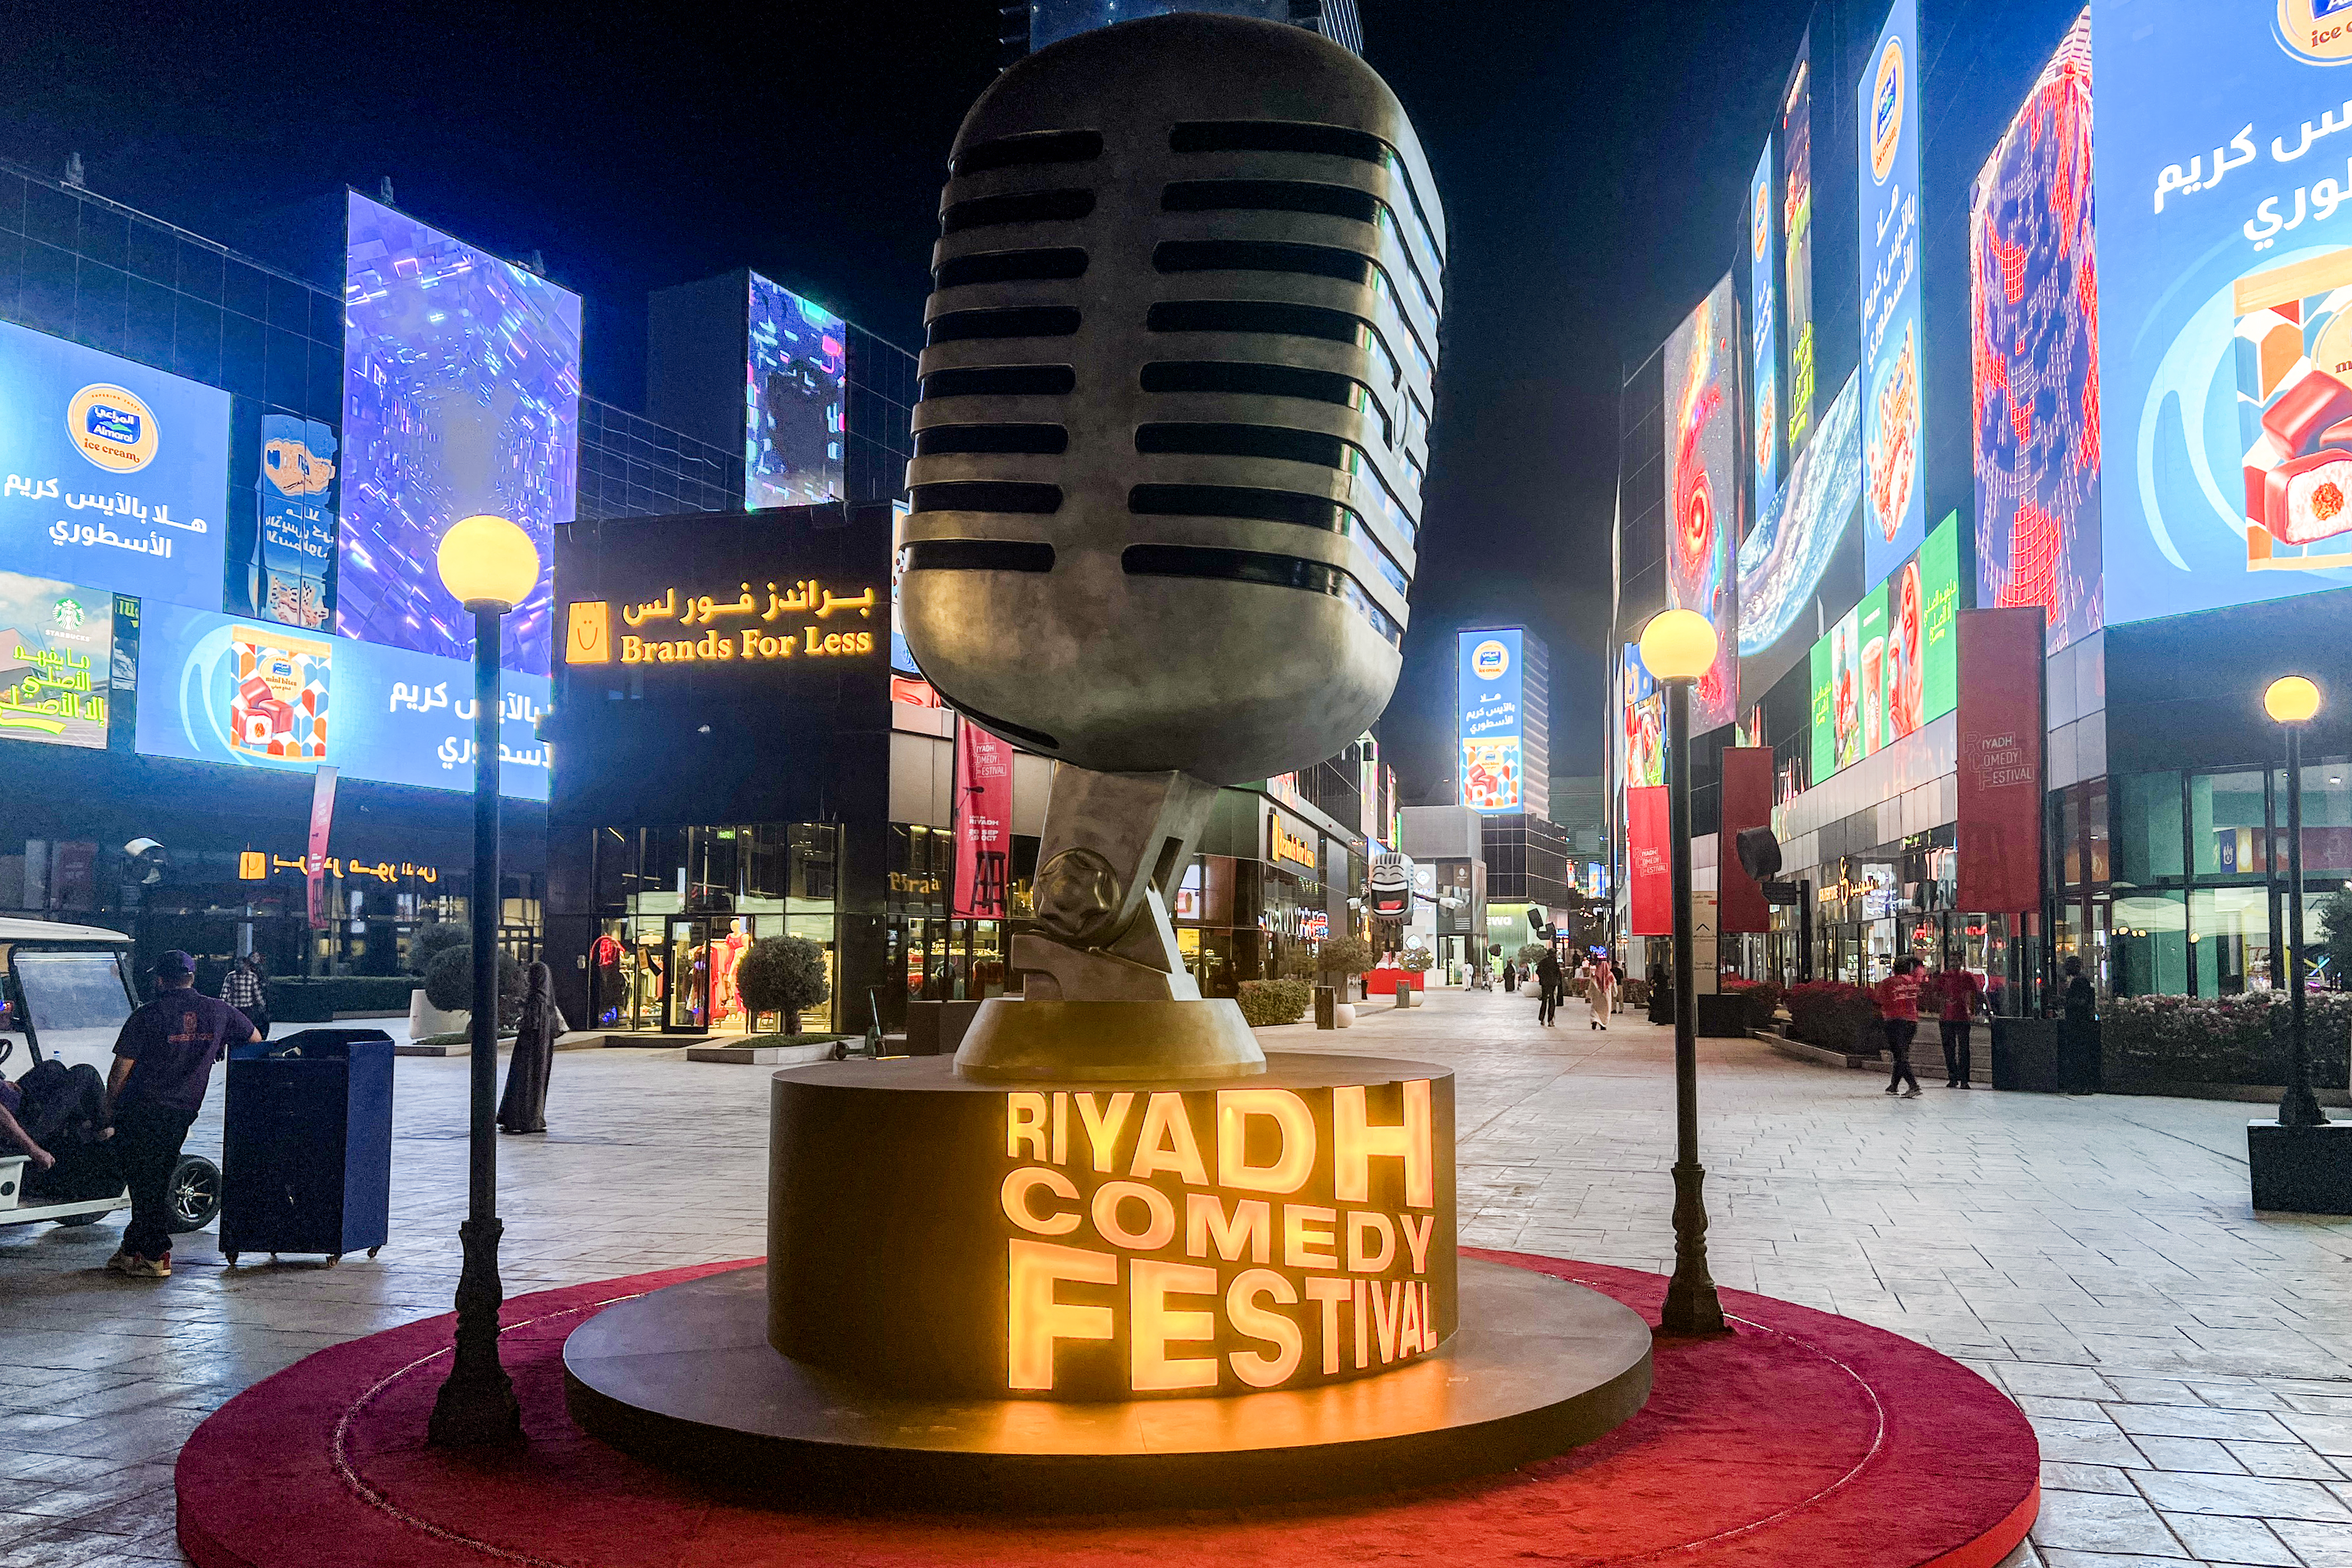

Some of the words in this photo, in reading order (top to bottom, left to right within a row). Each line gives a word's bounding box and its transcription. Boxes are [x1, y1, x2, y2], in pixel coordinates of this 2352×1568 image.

[2312, 27, 2341, 47] ice
[2154, 121, 2256, 214] كريم
[94, 406, 134, 425] المراعي
[93, 425, 132, 443] Almarai
[84, 438, 100, 450] ice
[102, 446, 140, 463] cream
[4, 474, 59, 499] كريم
[65, 491, 147, 524] بالآيس
[152, 504, 207, 533] هلا
[48, 520, 171, 558] الأسطوري
[622, 587, 674, 626] لس
[679, 582, 754, 624] فور
[761, 579, 871, 620] براندز
[45, 630, 91, 642] STARBUCKS
[621, 630, 732, 662] Brands
[740, 629, 795, 657] For
[804, 626, 871, 654] Less
[13, 645, 64, 671] يفهم
[66, 647, 90, 669] ما
[22, 666, 91, 699] الأصلي
[390, 681, 448, 713] كريم
[0, 684, 79, 719] الأصل
[84, 695, 105, 728] إلا
[1466, 707, 1484, 722] كريم
[1963, 731, 2012, 753] RIYADH
[1969, 751, 2018, 773] COMEDY
[1979, 767, 2032, 791] FESTIVAL
[1007, 1078, 1434, 1209] RIYADH
[1001, 1166, 1434, 1274] COMEDY
[1008, 1238, 1437, 1391] FESTIVAL
